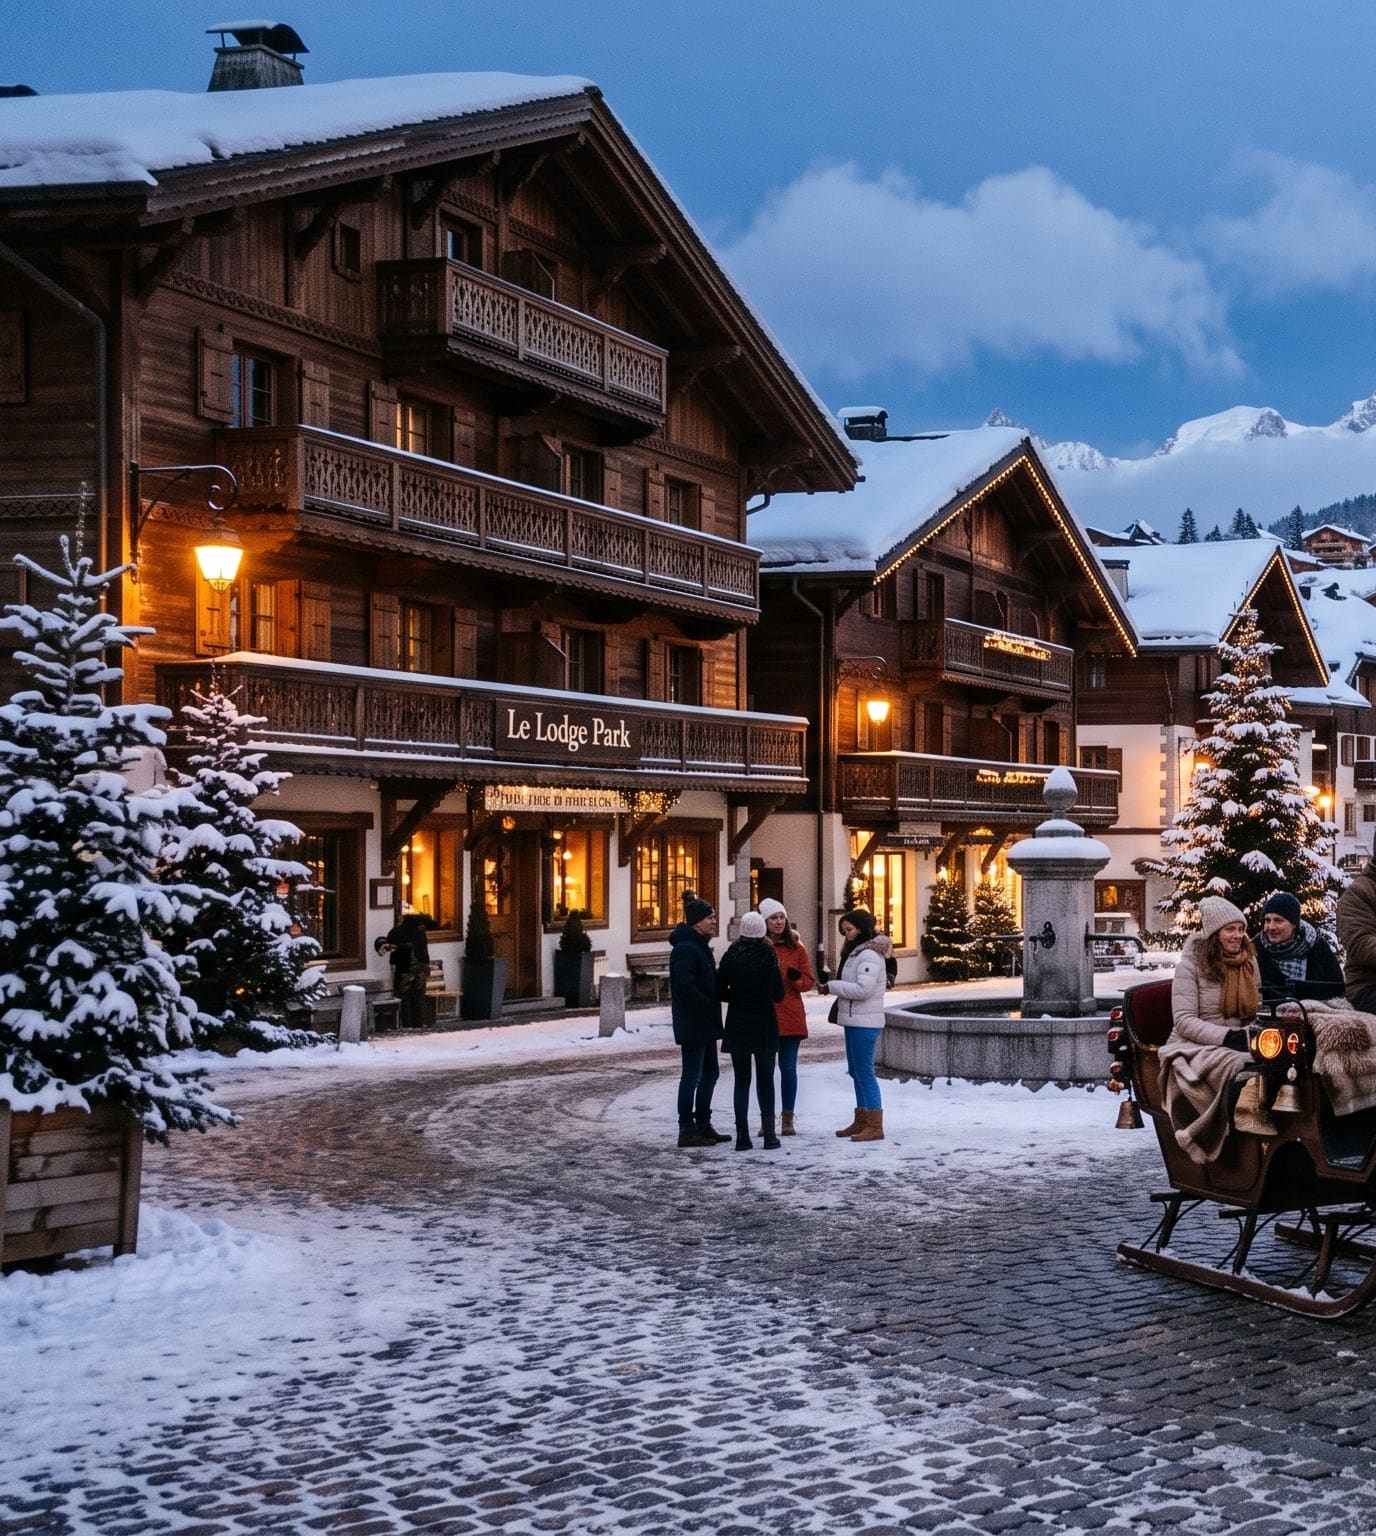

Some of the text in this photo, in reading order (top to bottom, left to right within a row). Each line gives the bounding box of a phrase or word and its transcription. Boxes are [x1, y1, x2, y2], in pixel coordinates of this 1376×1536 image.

[507, 708, 631, 752] Le Lodge Park
